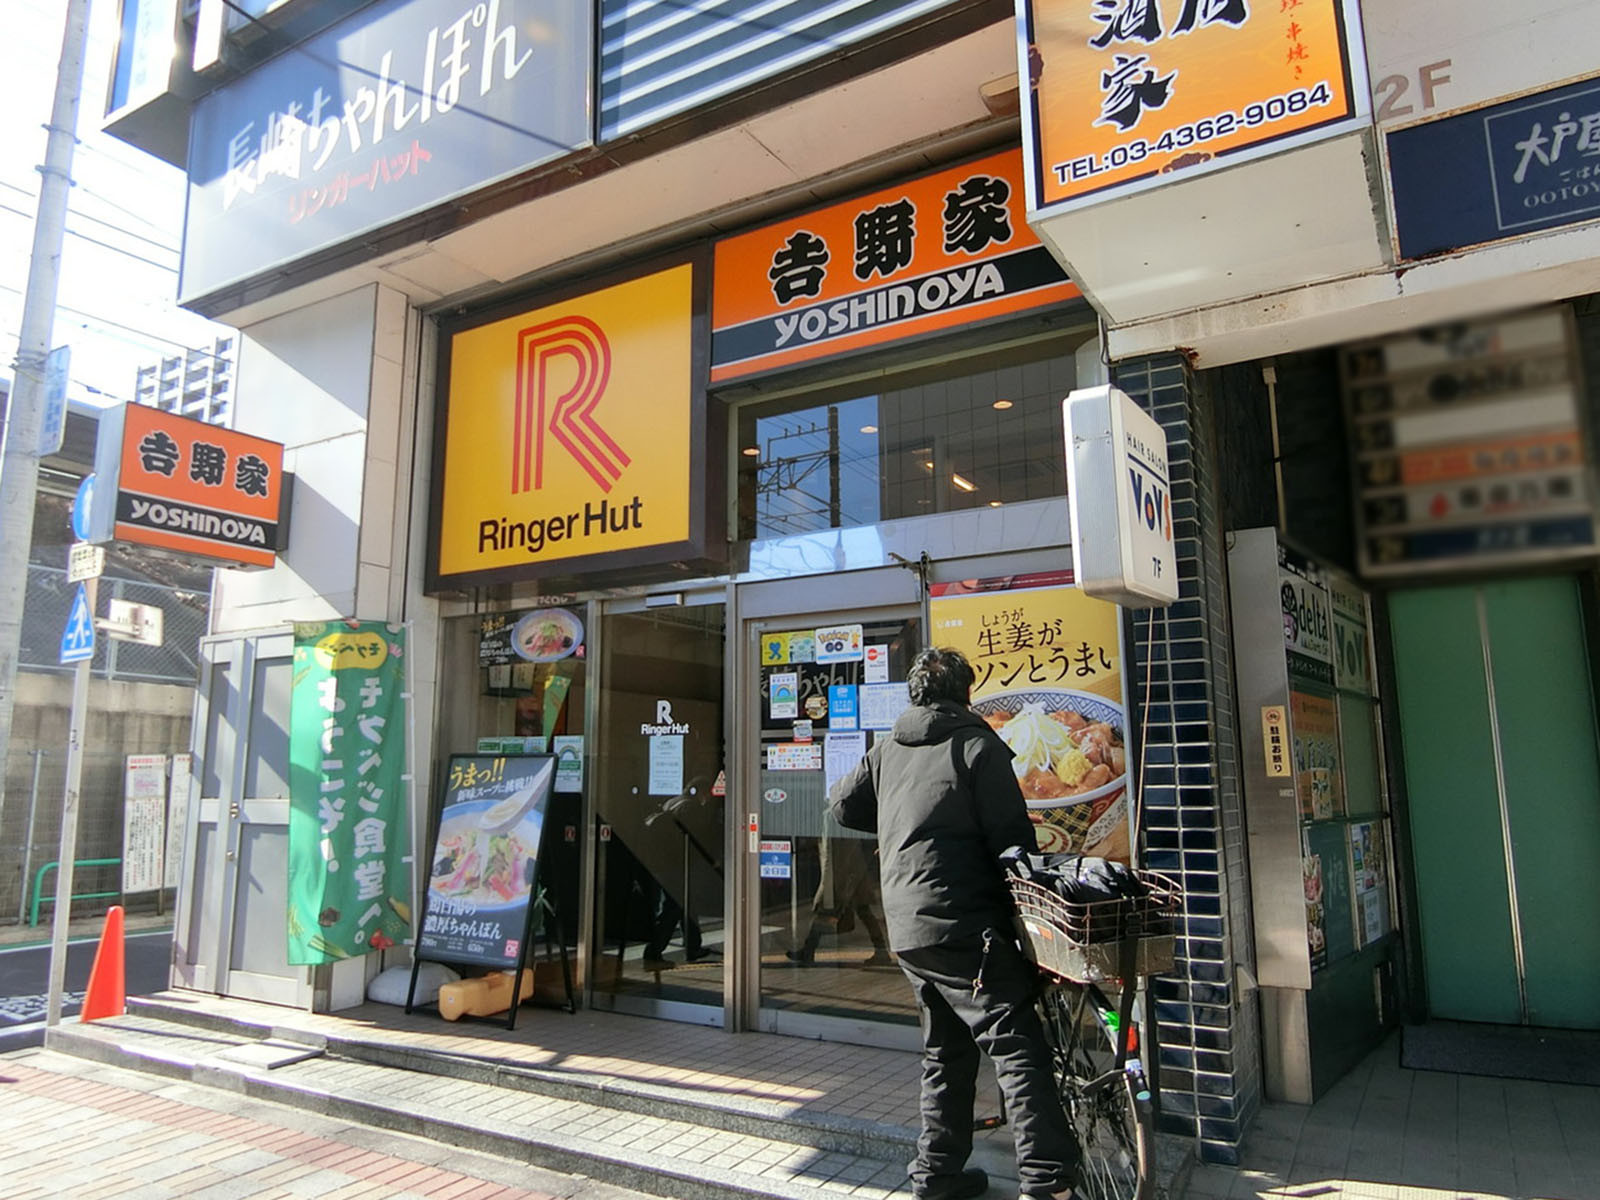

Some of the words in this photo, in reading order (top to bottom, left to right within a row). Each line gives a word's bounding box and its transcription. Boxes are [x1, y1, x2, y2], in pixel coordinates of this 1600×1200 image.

[223, 0, 533, 211] 長崎ちゃんぽん
[1375, 59, 1452, 122] 2F
[1054, 83, 1331, 184] TEL:03-4362-9084
[288, 139, 432, 225] リンガーハット
[769, 175, 1013, 305] 吉野家
[774, 261, 1006, 349] YOSHINOYA
[138, 431, 270, 498] 吉野家
[1126, 432, 1145, 457] HAIR
[1147, 446, 1167, 475] SALON
[131, 500, 266, 544] YOSHINOYA
[478, 513, 580, 553] Ringer
[582, 496, 643, 537] Hut
[1152, 556, 1162, 578] 7F
[976, 618, 1063, 658] 生姜が
[981, 607, 1024, 628] しょうが
[641, 723, 672, 736] Ringer
[671, 722, 690, 734] Hut
[656, 699, 674, 725] R
